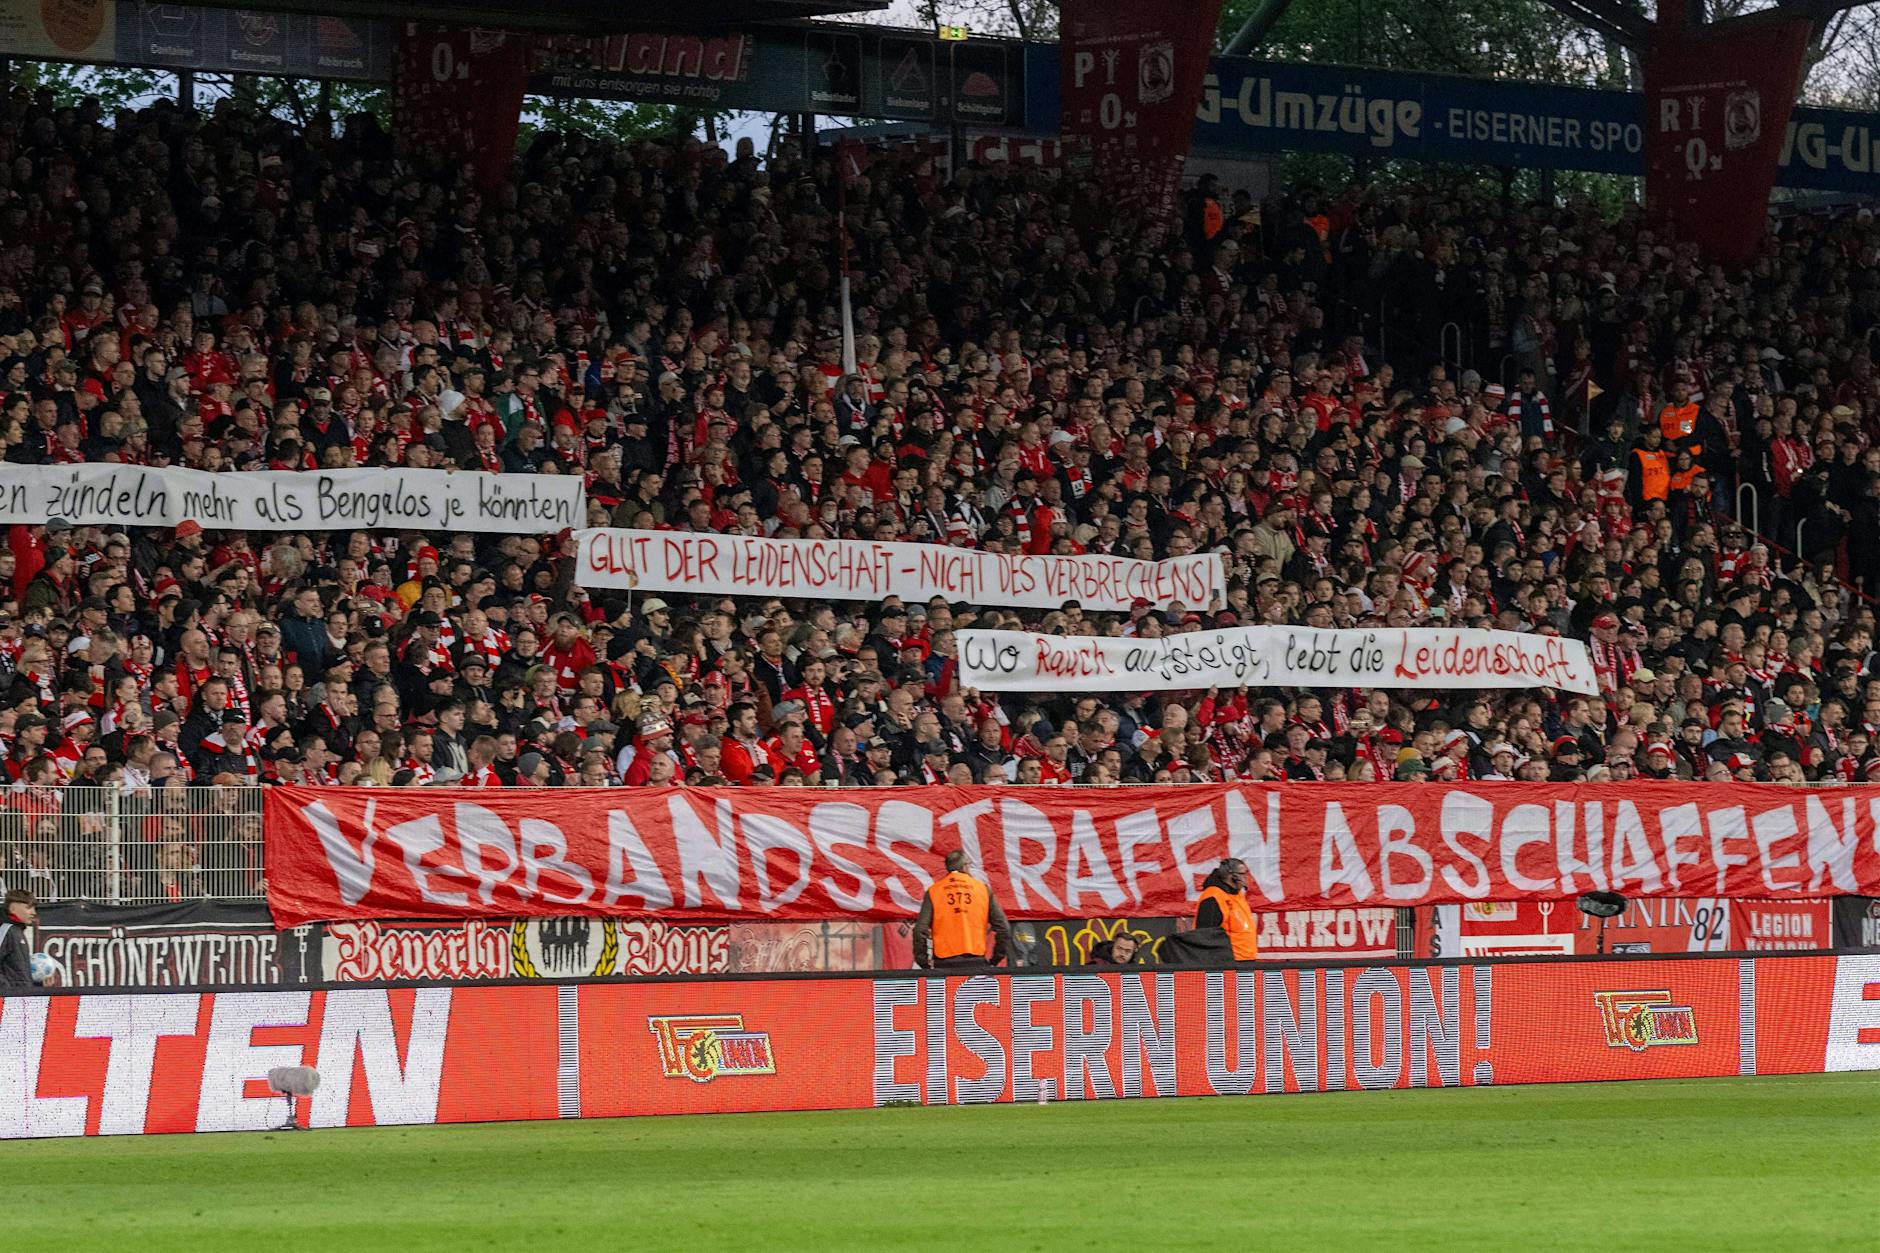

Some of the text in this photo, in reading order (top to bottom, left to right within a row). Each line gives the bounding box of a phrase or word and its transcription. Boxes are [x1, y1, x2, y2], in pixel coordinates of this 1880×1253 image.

[551, 74, 571, 88] mit
[573, 76, 595, 89] uns
[599, 78, 660, 96] entsorgen
[664, 81, 681, 95] sie
[1448, 107, 1581, 149] EISERNER
[46, 471, 167, 517] zündeln
[183, 481, 238, 522] mehr
[255, 482, 304, 523] als
[317, 475, 431, 527] Bengalos
[440, 484, 465, 528] je
[589, 532, 651, 575] GLUT
[663, 537, 720, 582] DER
[732, 539, 894, 594] LEIDENSCHAFT
[919, 549, 987, 599] NICHT
[998, 553, 1036, 596] DES
[964, 636, 1020, 673] Wo
[1034, 637, 1115, 678] Rauch
[1124, 635, 1272, 681] aufsteigt,
[1285, 633, 1341, 674] lebt
[1350, 633, 1384, 673] die
[302, 789, 1283, 912] VERBANDSSTRAFEN
[947, 892, 972, 905] 373
[1252, 906, 1395, 948] ANKOW
[1693, 906, 1725, 941] 82
[1749, 910, 1813, 938] LEGION
[328, 916, 511, 981] Beverly
[621, 916, 730, 976] Boys
[872, 965, 1494, 1107] EISERN UNION!
